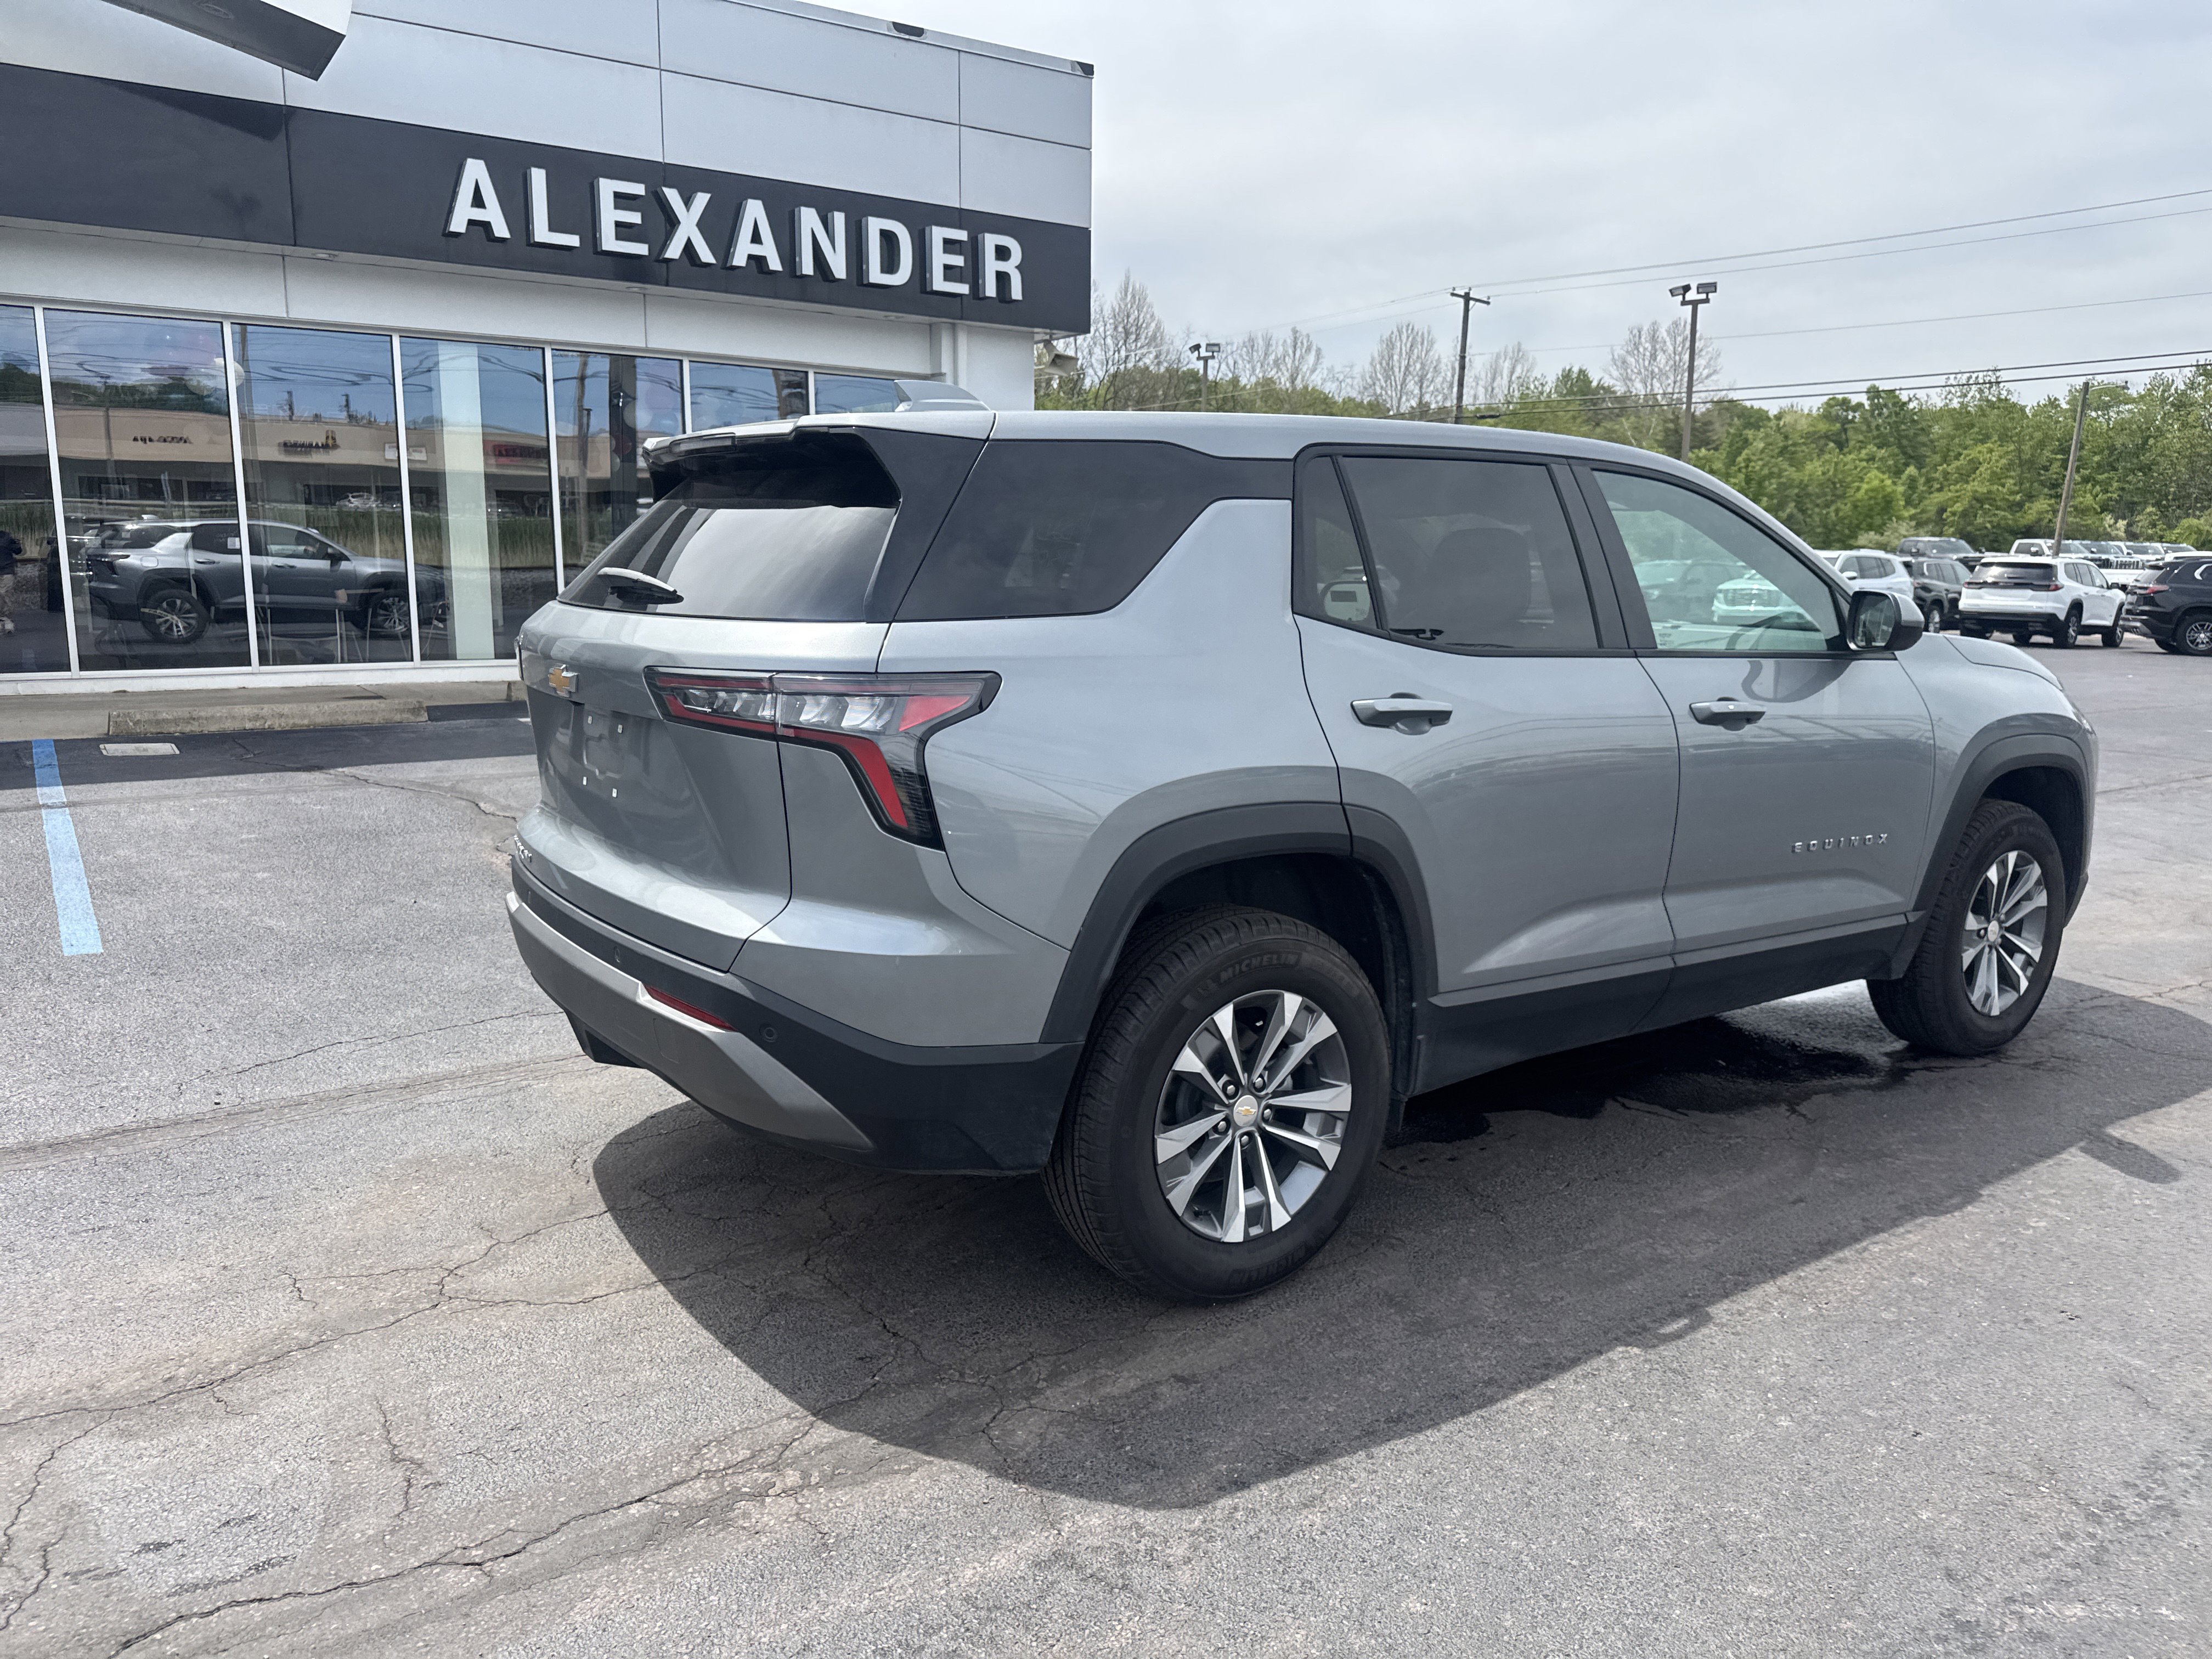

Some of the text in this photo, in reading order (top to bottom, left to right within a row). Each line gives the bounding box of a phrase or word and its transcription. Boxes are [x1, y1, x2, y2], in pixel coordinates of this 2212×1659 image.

[446, 157, 1023, 301] ALEXANDER
[1792, 833, 1888, 853] EQUINOX
[1219, 953, 1299, 984] MICHELIN
